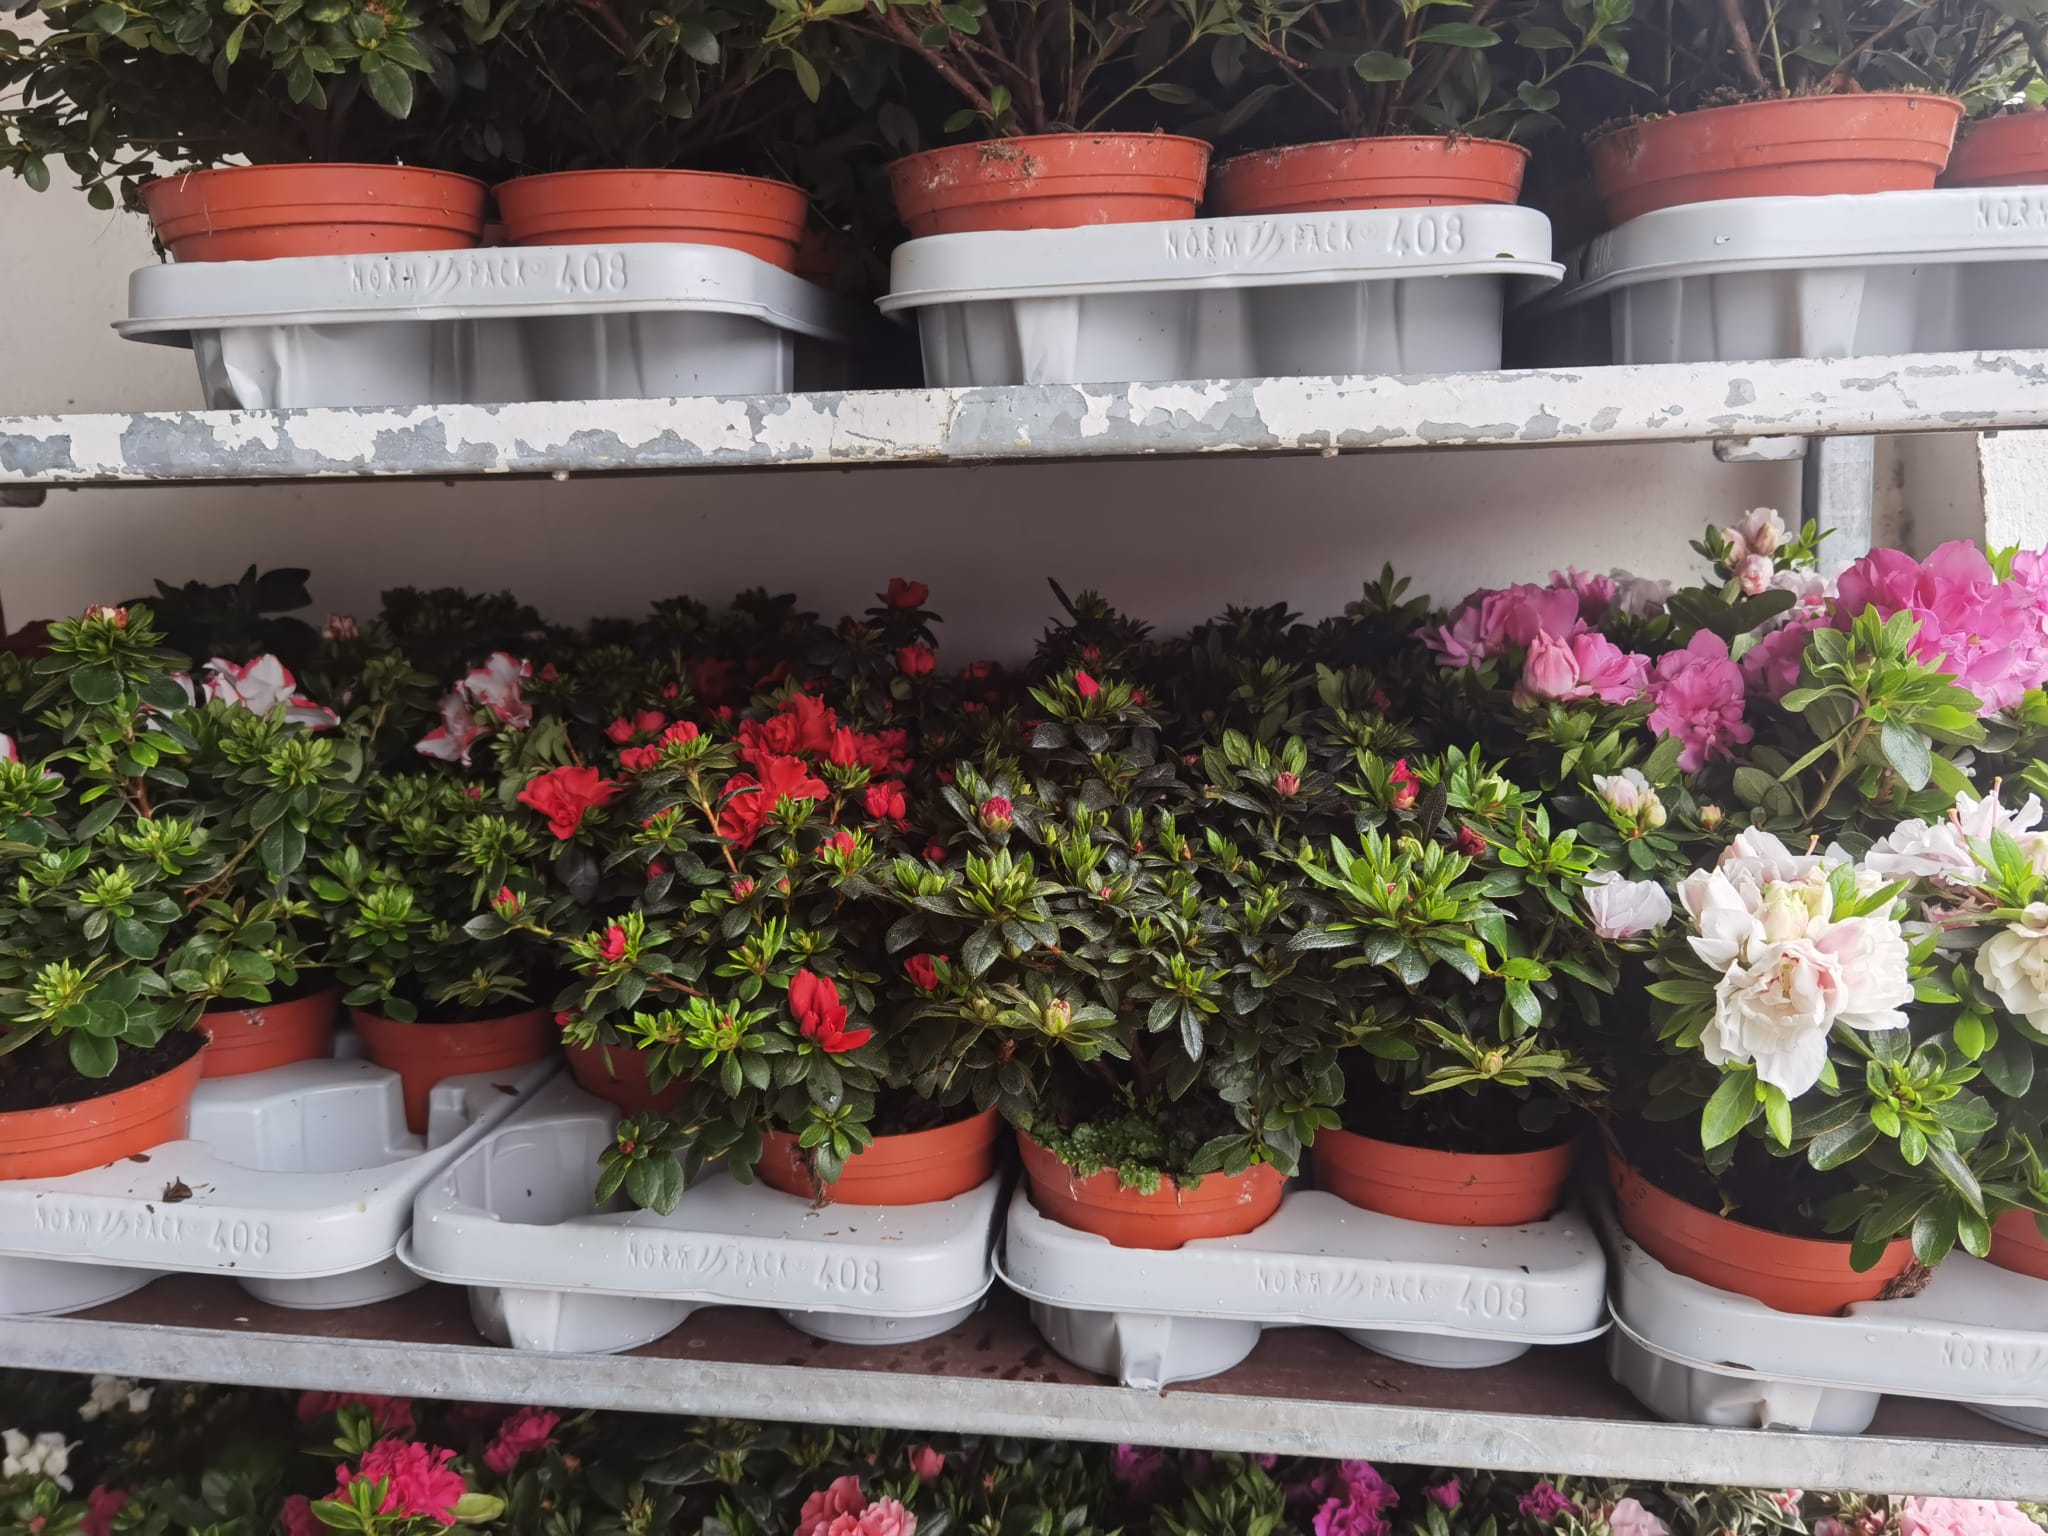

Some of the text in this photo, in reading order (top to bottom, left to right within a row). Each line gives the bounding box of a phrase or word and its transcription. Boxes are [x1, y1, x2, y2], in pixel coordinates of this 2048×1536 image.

[1165, 213, 1465, 260] NORM PACK 408
[351, 249, 629, 294] NORM PACK 408
[34, 1207, 271, 1257] NORM PACK 408
[627, 1239, 882, 1295] NORM PACK 408
[1255, 1267, 1528, 1321] NORM PACK 408
[1941, 1341, 2015, 1373] NORM
